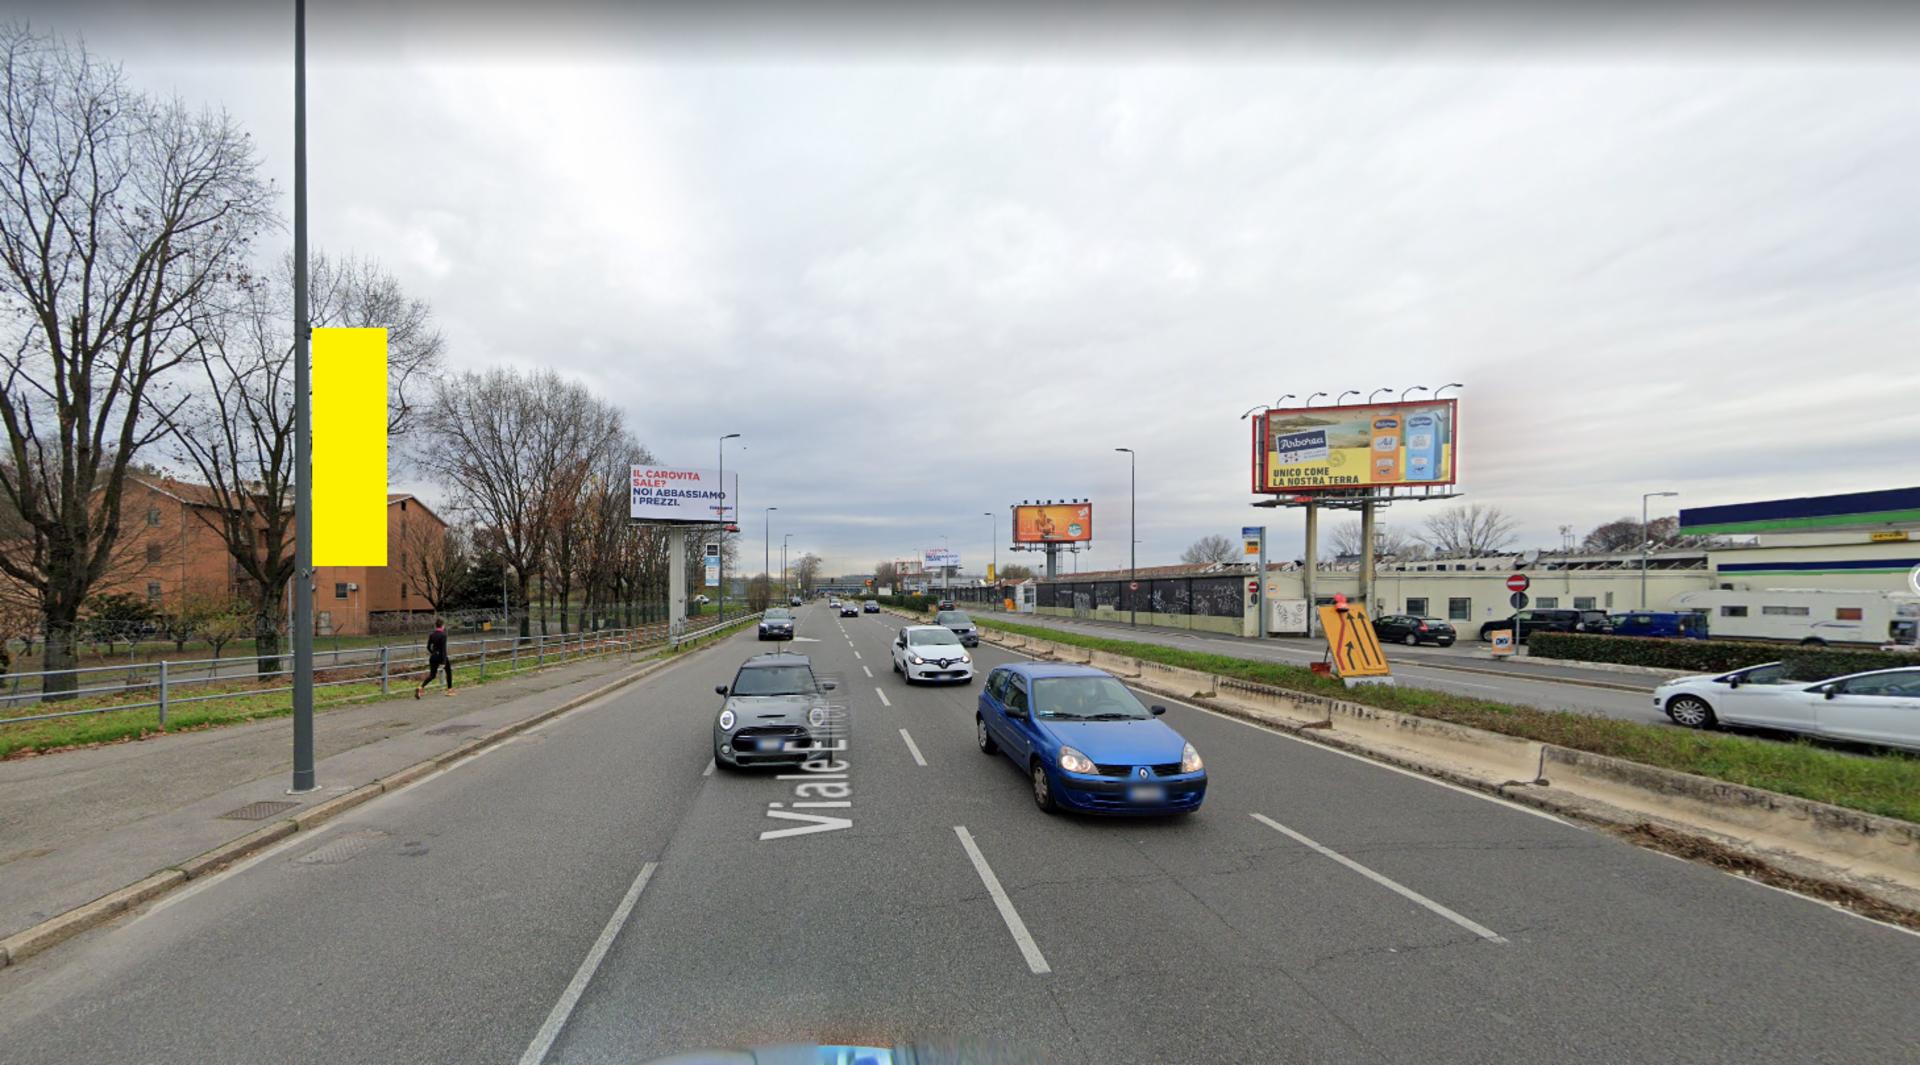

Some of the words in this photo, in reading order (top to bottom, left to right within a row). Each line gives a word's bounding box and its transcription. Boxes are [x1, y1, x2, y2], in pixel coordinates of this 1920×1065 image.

[1280, 436, 1325, 450] Arborea
[646, 470, 700, 480] CAROVITA
[1273, 468, 1302, 477] UNICO
[1304, 467, 1330, 476] COME
[633, 480, 666, 488] SALE?
[1273, 478, 1285, 487] LA
[1287, 476, 1325, 486] NOSTRA
[1328, 475, 1359, 484] TERRA
[633, 488, 653, 496] NOI
[656, 488, 726, 500] ABBASSIAMO
[639, 497, 680, 506] PREZZI.
